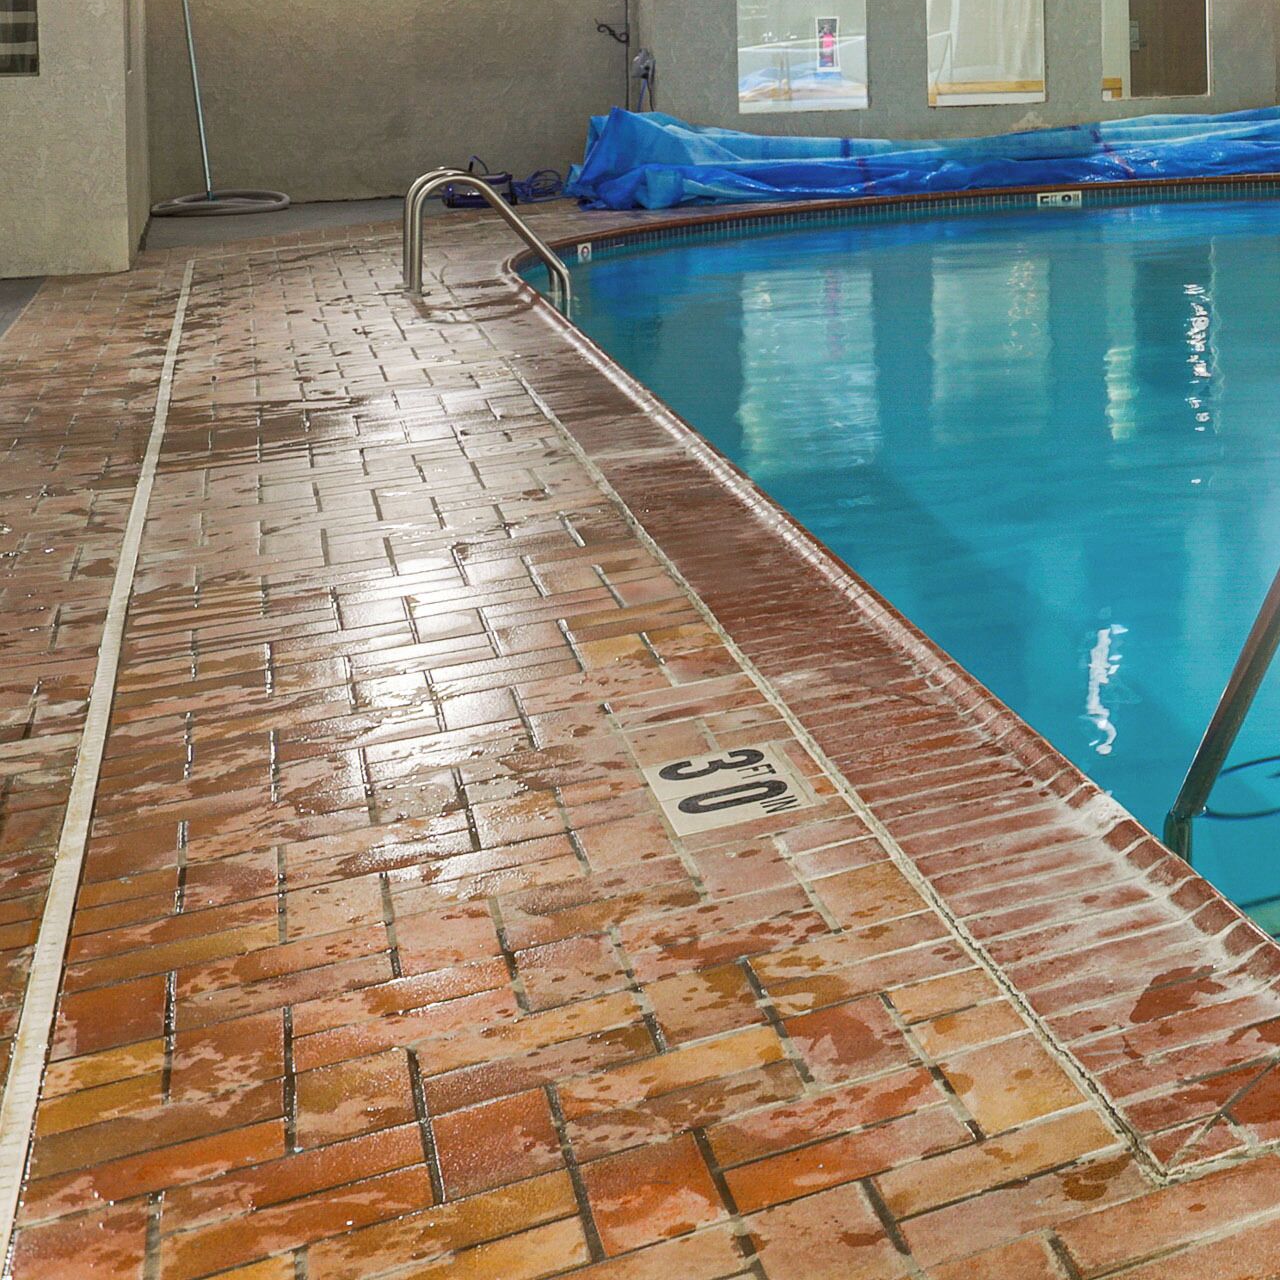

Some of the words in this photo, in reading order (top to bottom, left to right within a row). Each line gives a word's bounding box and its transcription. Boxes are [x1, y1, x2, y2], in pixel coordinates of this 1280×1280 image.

[659, 748, 765, 781] 3
[736, 763, 777, 780] FT
[678, 780, 788, 814] 0
[759, 794, 801, 814] IN
